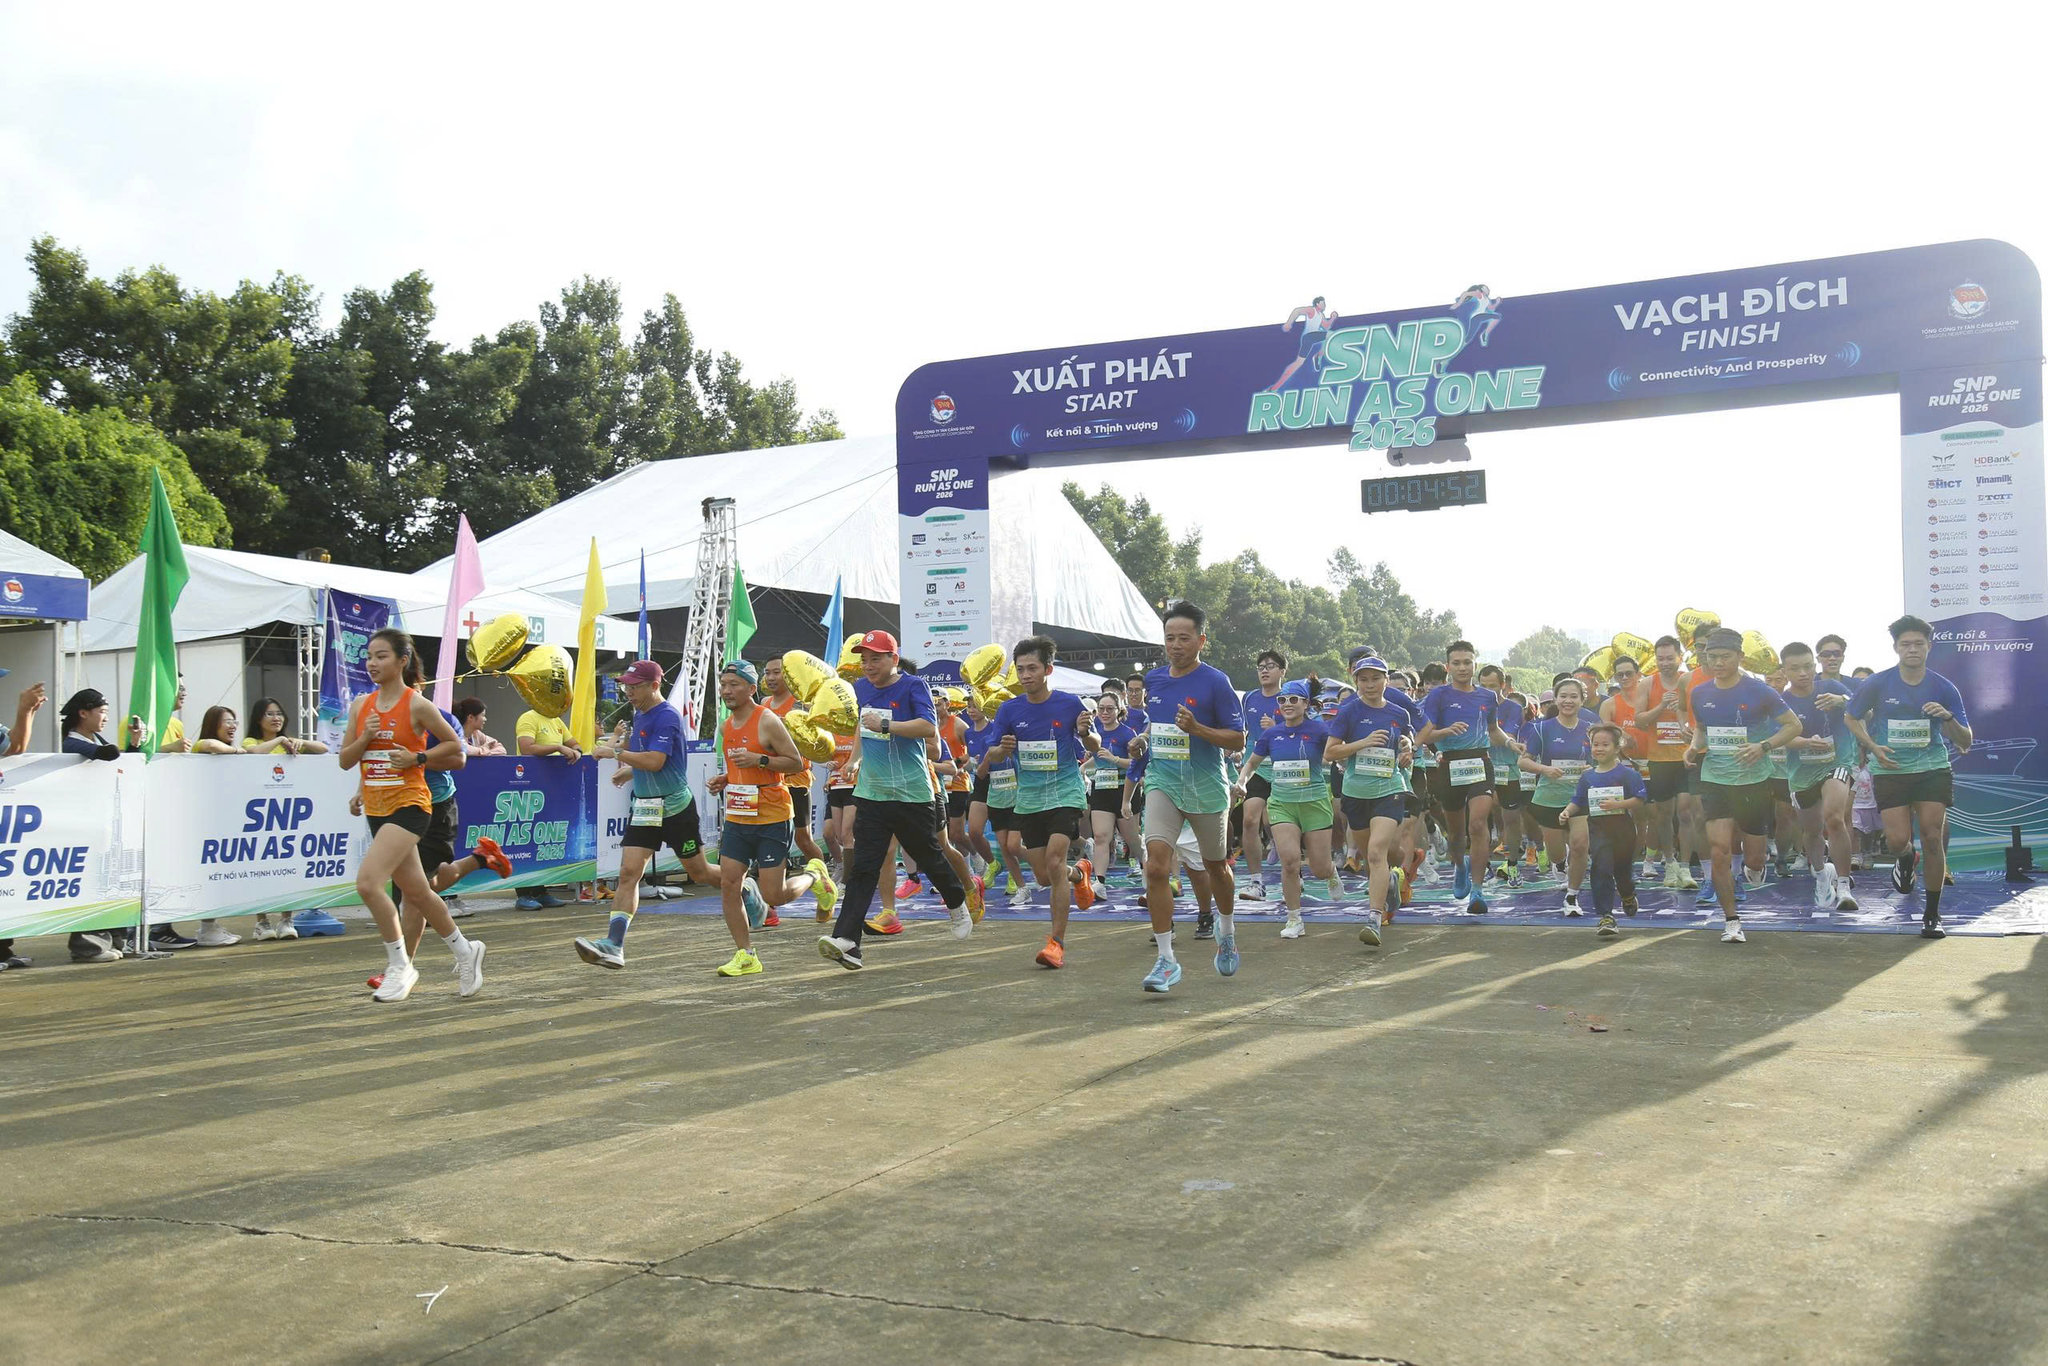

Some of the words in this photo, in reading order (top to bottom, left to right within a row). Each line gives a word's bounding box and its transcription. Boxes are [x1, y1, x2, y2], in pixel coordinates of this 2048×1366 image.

[1613, 291, 1728, 336] VẠCH
[1740, 276, 1848, 317] ĐÍCH
[1680, 321, 1781, 352] FINISH
[1320, 317, 1465, 385] SNP
[1012, 355, 1096, 394] XUẤT
[1105, 348, 1193, 385] PHÁT
[1639, 363, 1722, 382] Connectivity
[1725, 361, 1753, 373] And
[1757, 353, 1828, 370] Prosperity
[1952, 376, 1997, 394] SNP
[1064, 389, 1139, 414] START
[1248, 383, 1352, 433] RUN
[1356, 377, 1428, 423] AS
[1435, 366, 1547, 417] ONE
[1928, 395, 1960, 407] RUN
[1964, 392, 1985, 404] AS
[1988, 388, 2022, 401] ONE
[1961, 403, 1989, 413] 2026
[1046, 427, 1064, 438] Kết
[1065, 424, 1083, 437] nối
[1084, 425, 1092, 434] &
[1093, 422, 1123, 436] Thịnh
[1125, 420, 1159, 434] vượng
[1348, 416, 1437, 452] 2026
[1974, 455, 2011, 464] HDBank
[930, 468, 959, 482] SNP
[1976, 475, 2012, 484] Vinamilk
[915, 483, 936, 493] RUN
[937, 481, 952, 491] AS
[953, 479, 974, 490] ONE
[936, 491, 954, 499] 2026
[1367, 474, 1480, 507] 00:04:52
[1932, 631, 1953, 641] Kết
[1956, 629, 1976, 640] nối
[1979, 630, 1987, 639] &
[1956, 642, 1990, 654] Thịnh
[1994, 641, 2034, 653] vượng
[932, 673, 944, 682] nối
[1157, 737, 1186, 747] 51084
[1027, 752, 1055, 760] 50407
[1366, 757, 1391, 766] 51222
[242, 797, 314, 833] SNP
[493, 790, 546, 823] SNP
[506, 822, 532, 847] AS
[533, 820, 570, 845] ONE
[606, 817, 628, 837] RU
[201, 837, 257, 864] RUN
[261, 835, 296, 860] AS
[300, 832, 350, 858] ONE
[536, 843, 566, 861] 2026
[23, 846, 90, 877] ONE
[305, 859, 346, 879] 2026
[208, 870, 223, 881] KẾT
[223, 869, 238, 880] NỐI
[238, 868, 249, 879] VÀ
[249, 869, 271, 880] THỊNH
[271, 867, 297, 879] VƯỢNG
[26, 877, 82, 901] 2026
